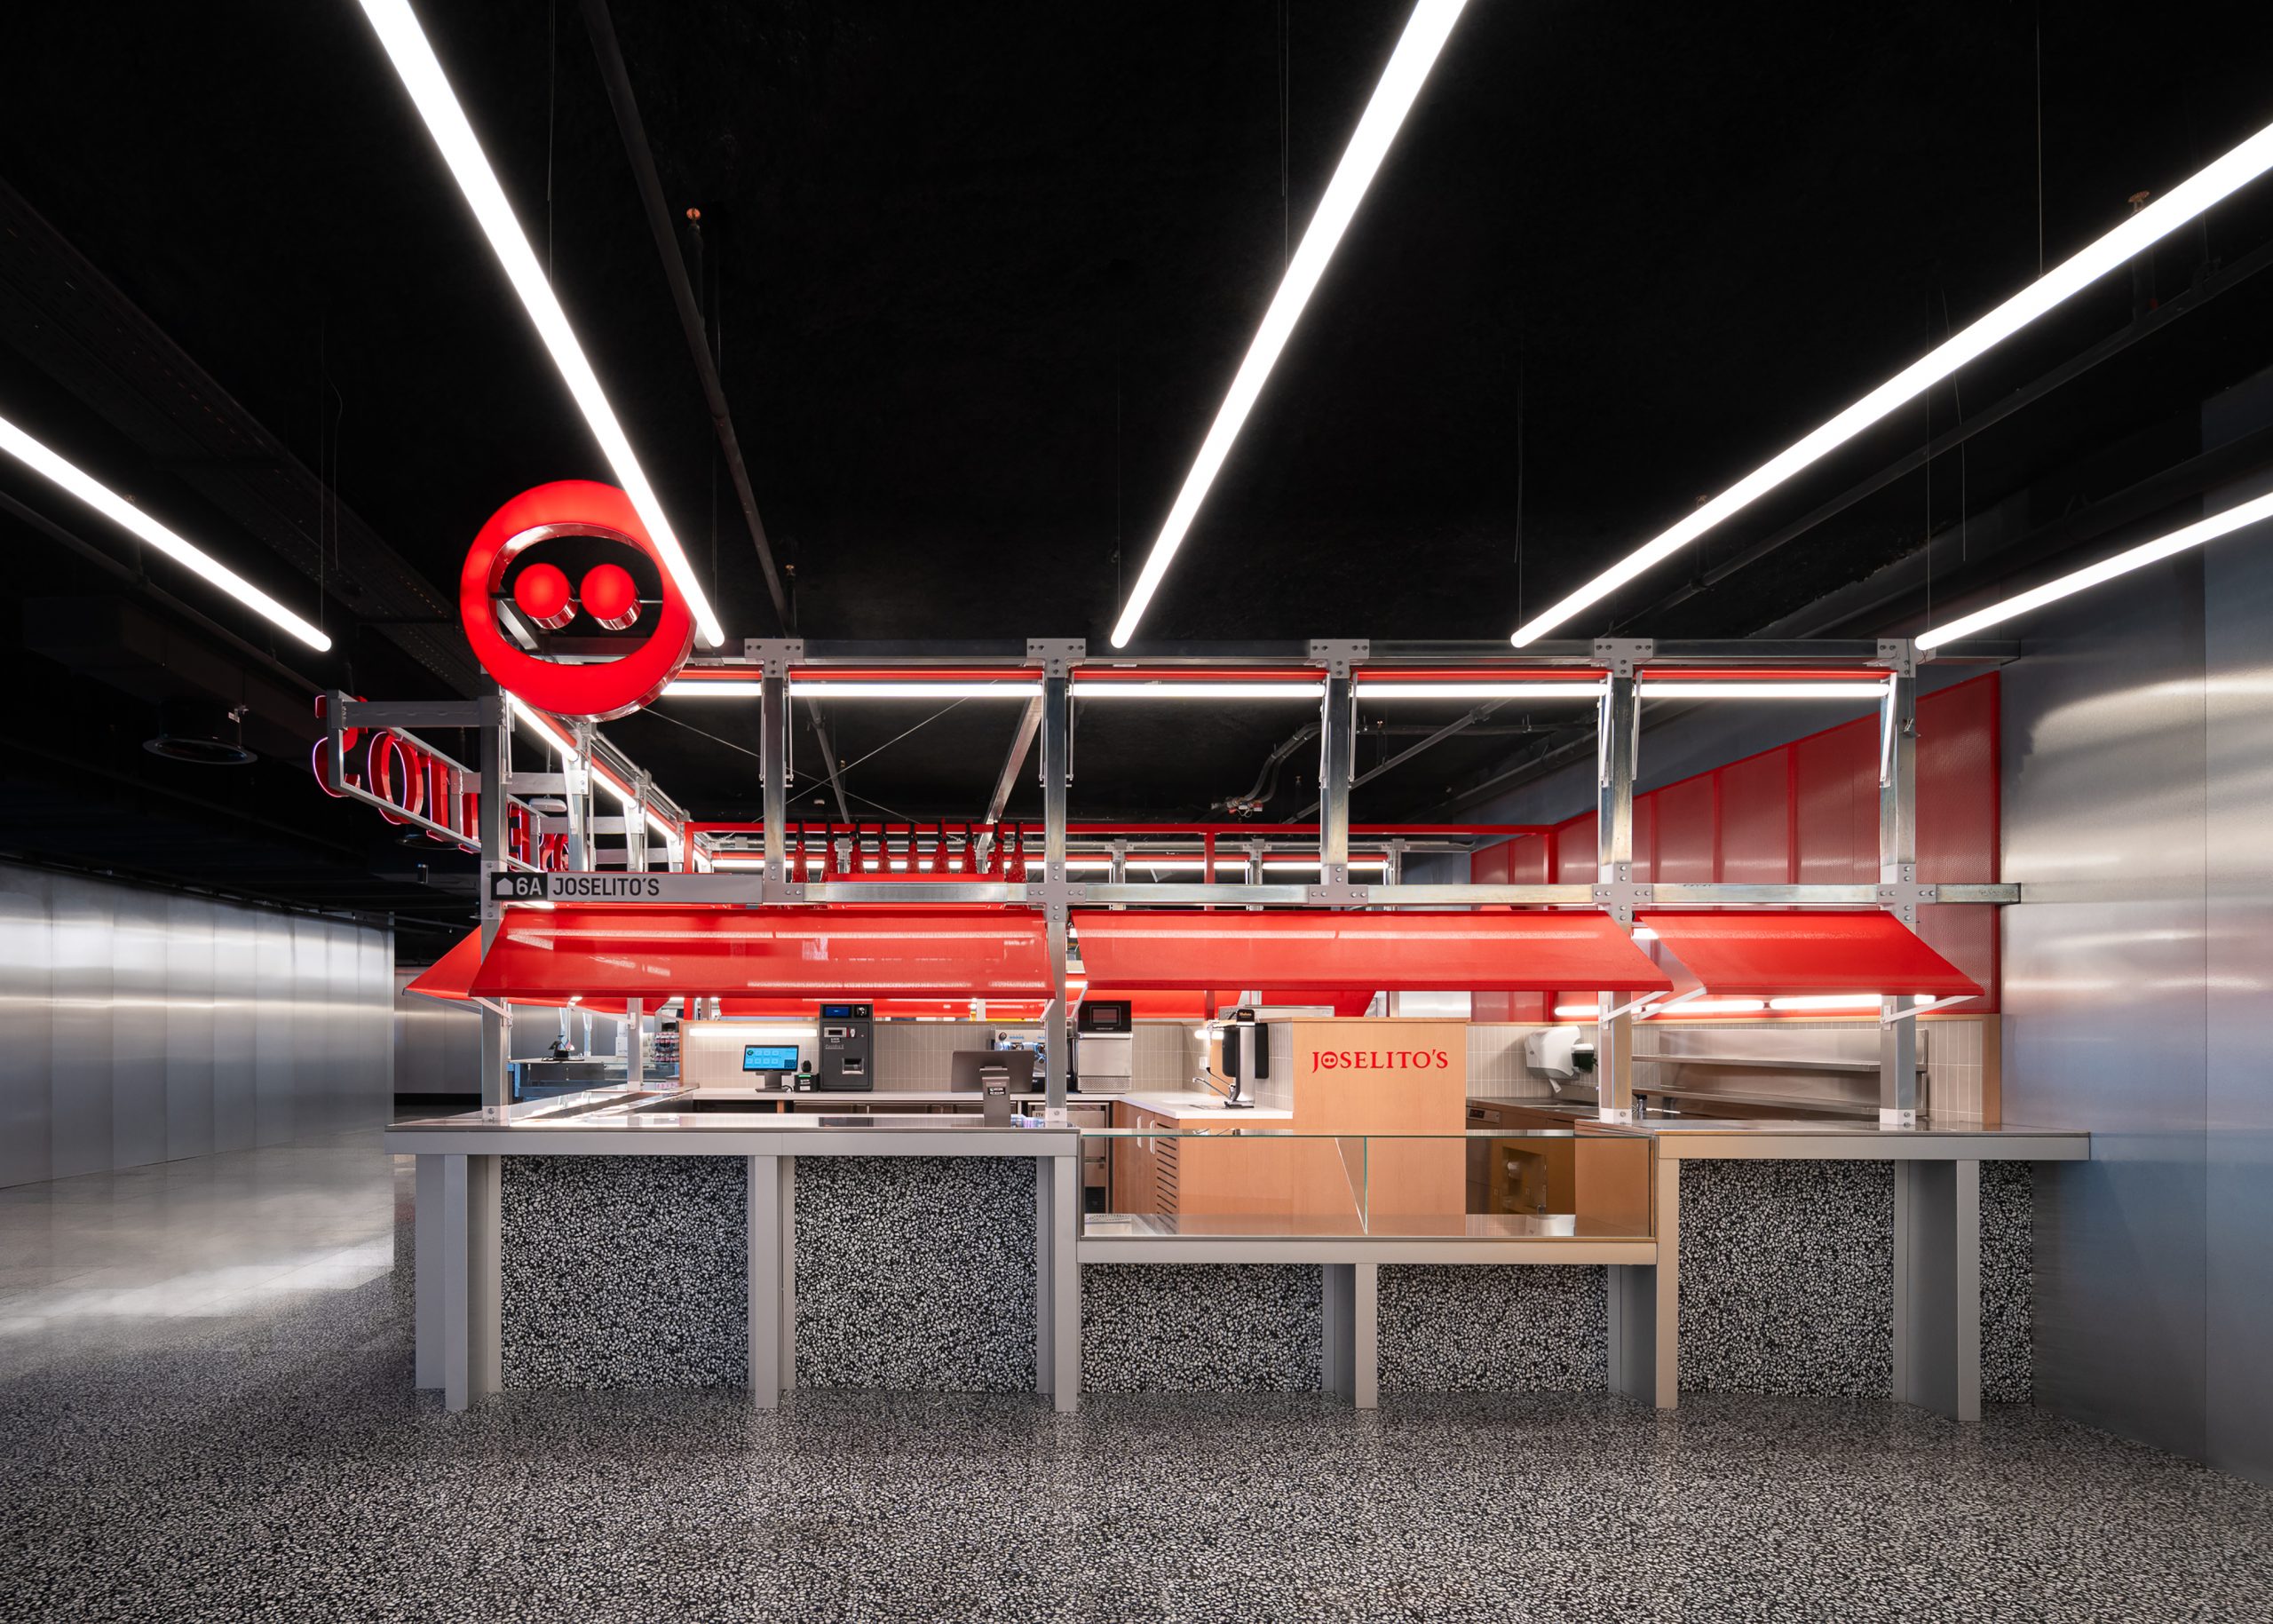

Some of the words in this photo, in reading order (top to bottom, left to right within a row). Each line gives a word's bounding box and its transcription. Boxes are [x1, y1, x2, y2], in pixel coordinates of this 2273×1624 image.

[516, 876, 543, 896] 6A
[552, 877, 660, 896] JOSELITO'S
[1311, 1049, 1449, 1073] JOSELITO'S
